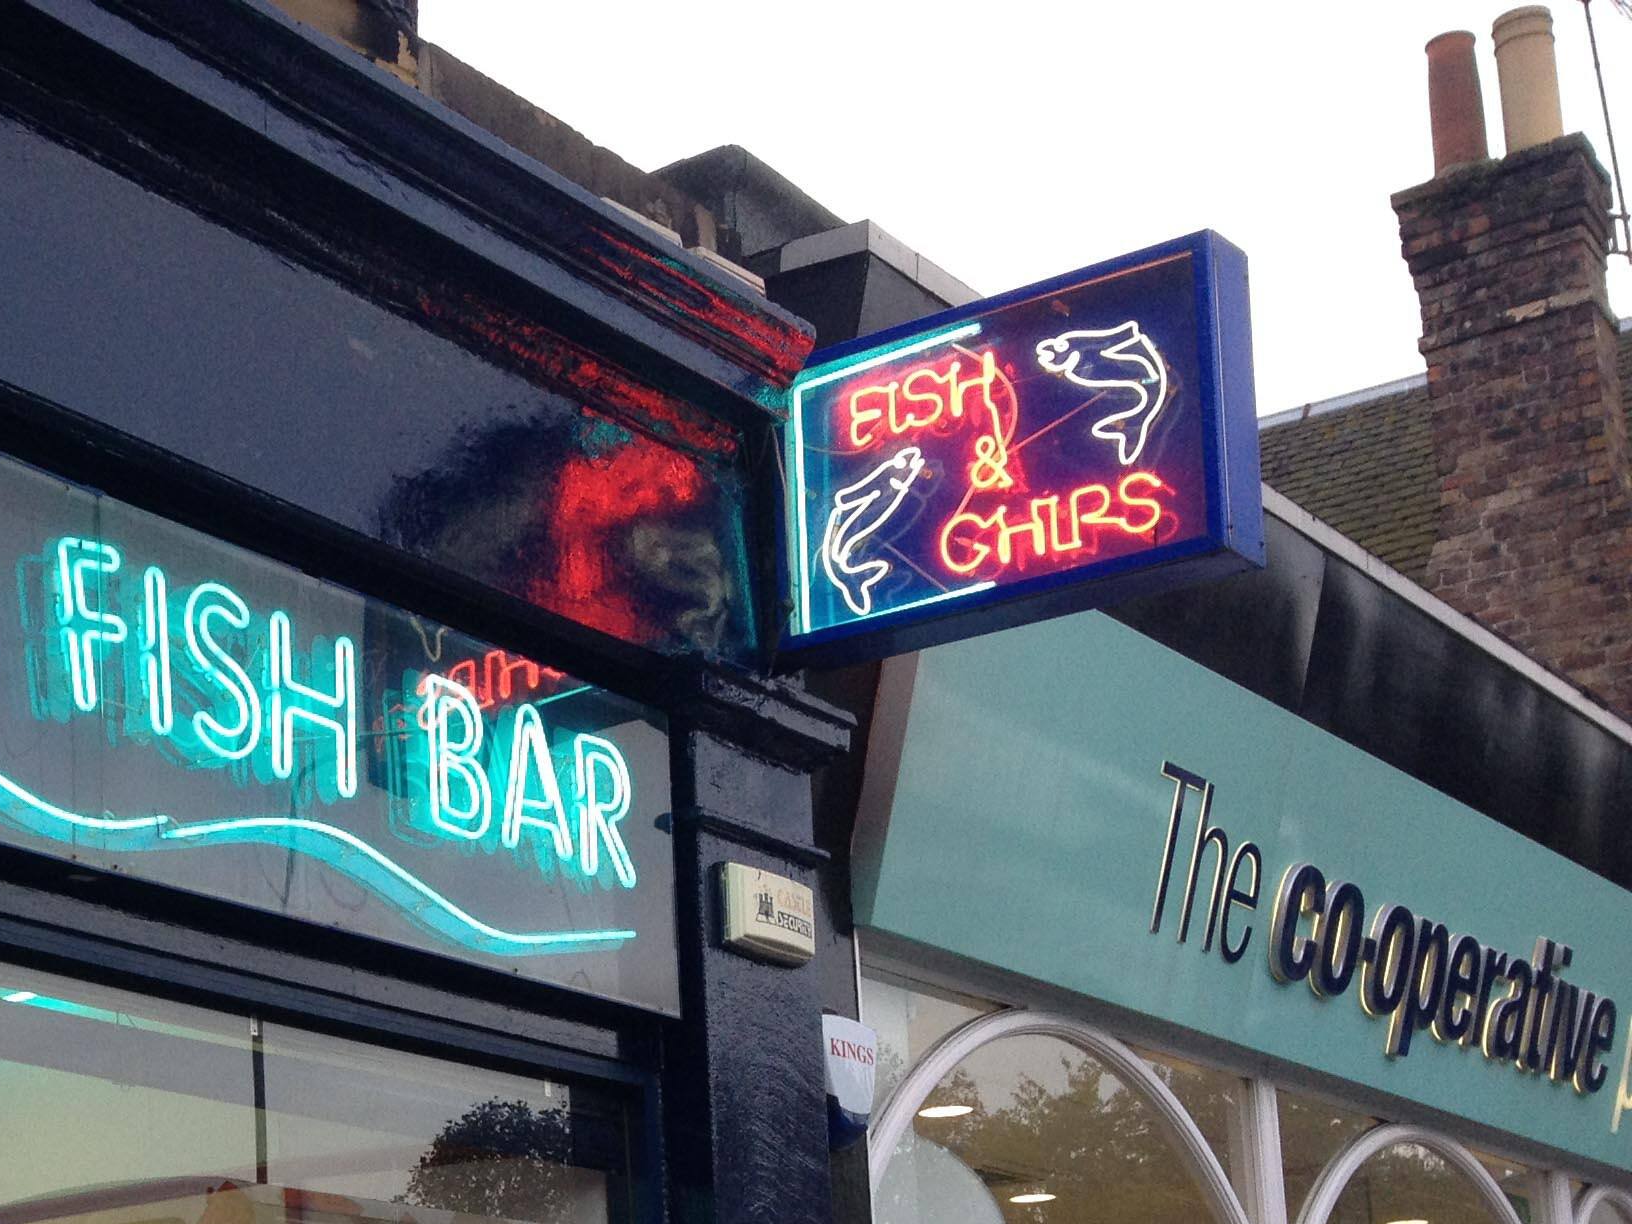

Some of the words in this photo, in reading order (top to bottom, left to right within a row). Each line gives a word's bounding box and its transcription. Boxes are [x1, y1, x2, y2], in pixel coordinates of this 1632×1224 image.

[849, 352, 995, 446] FISH
[970, 436, 1013, 488] &
[940, 473, 1161, 573] CHIPS
[58, 537, 355, 797] FISH
[427, 674, 636, 887] BAR
[1150, 760, 1262, 963] The
[1268, 863, 1616, 1093] co-operative
[831, 1038, 874, 1064] KINGS
